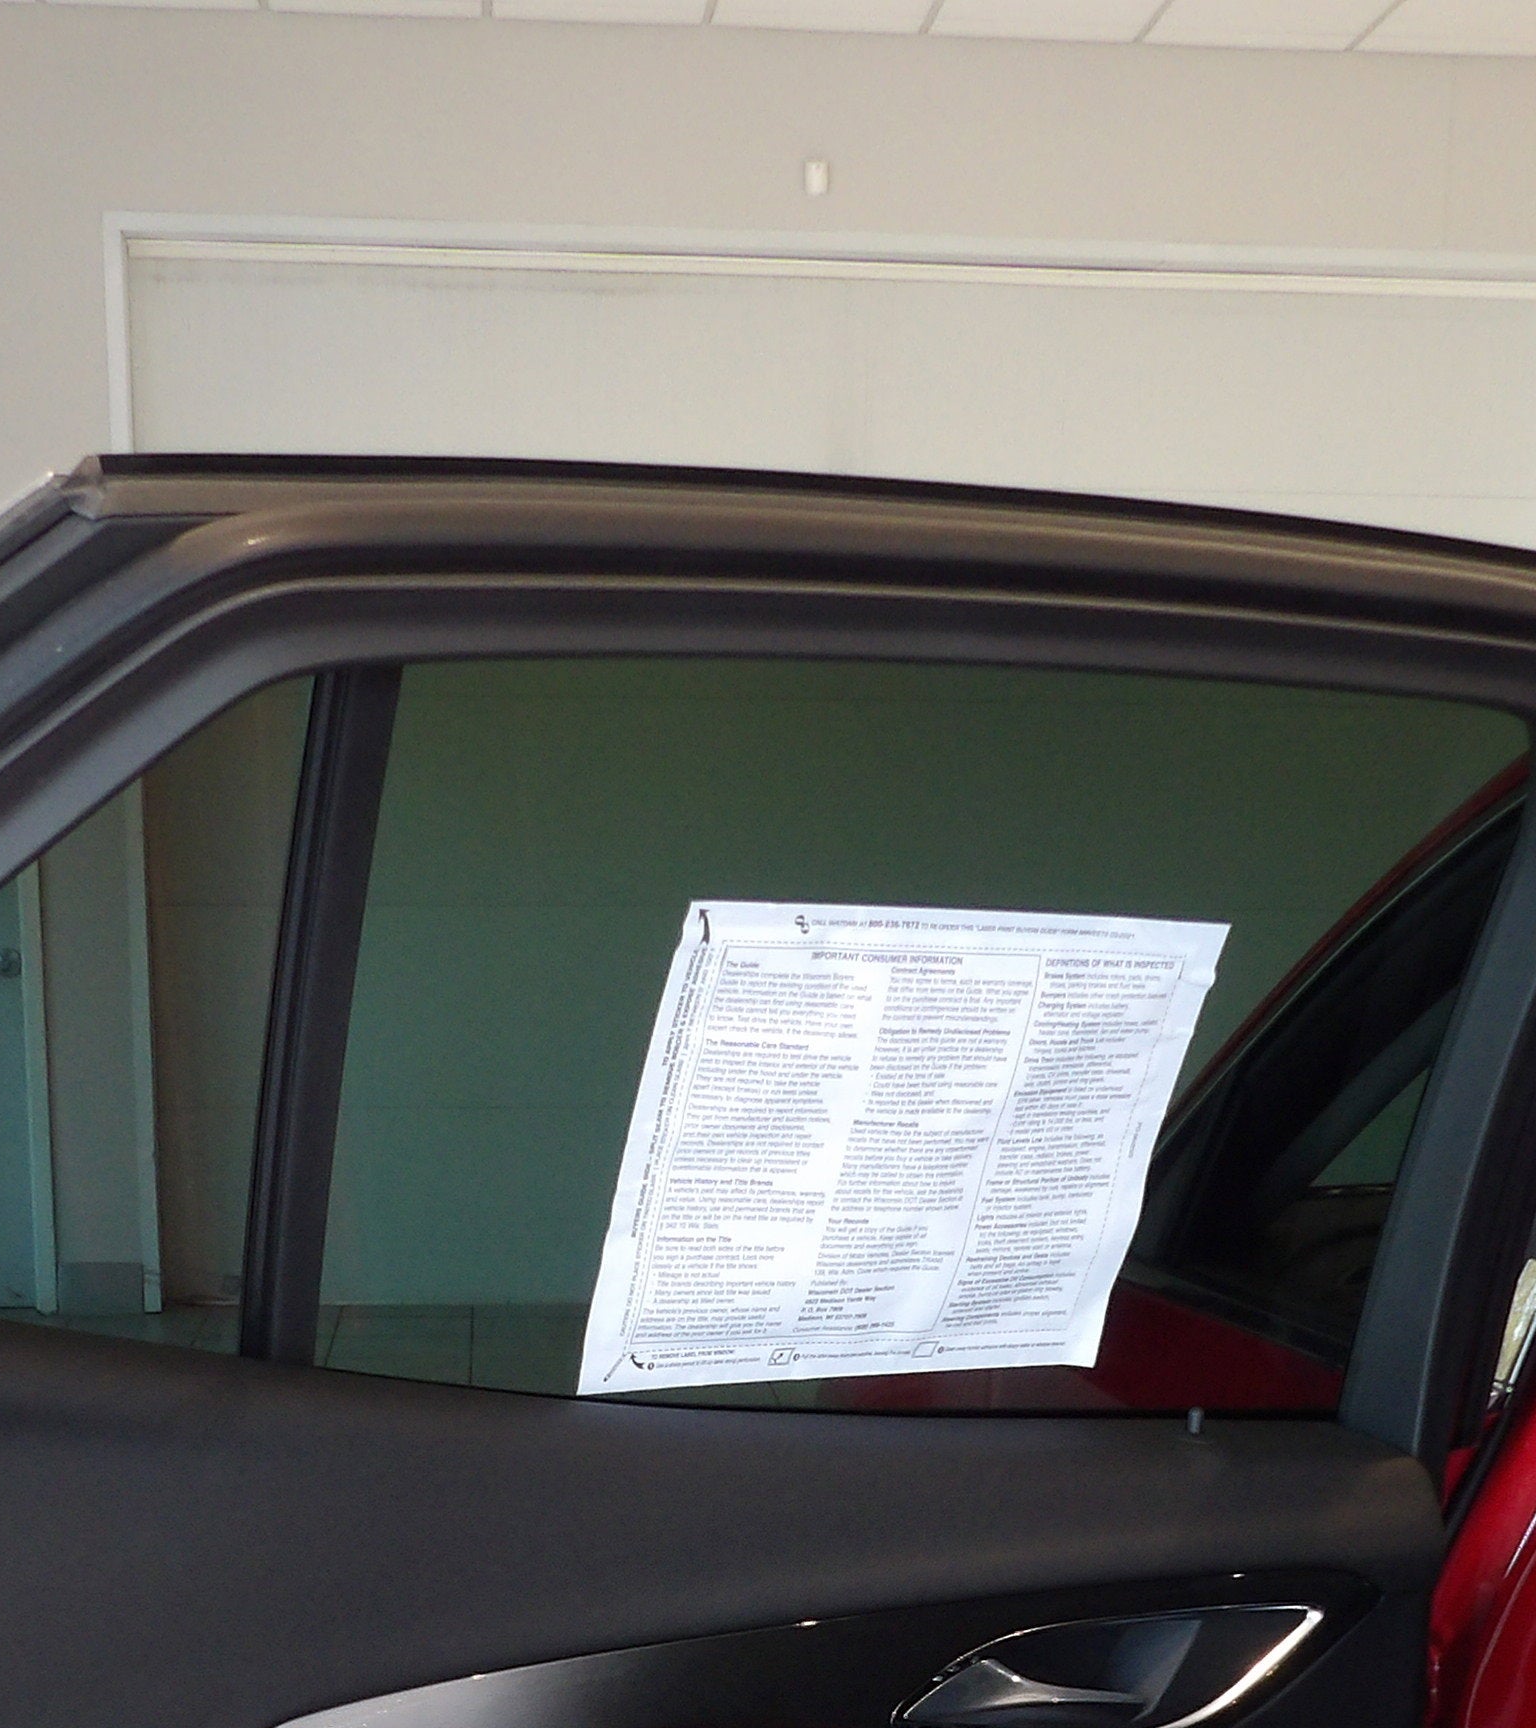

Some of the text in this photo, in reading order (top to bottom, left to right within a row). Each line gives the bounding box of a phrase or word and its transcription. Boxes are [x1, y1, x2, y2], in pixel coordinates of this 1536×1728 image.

[811, 951, 964, 966] IMPORTANT CONSUMER INFORMATION
[1045, 959, 1175, 970] DEFINITIONS OF WHAT IS INSPECTED
[891, 966, 956, 977] Contract Agreements
[706, 1038, 809, 1051] The Reasonable Care Standard
[670, 1178, 692, 1186] Vehicle
[694, 1178, 718, 1187] History
[750, 1180, 773, 1188] Brands
